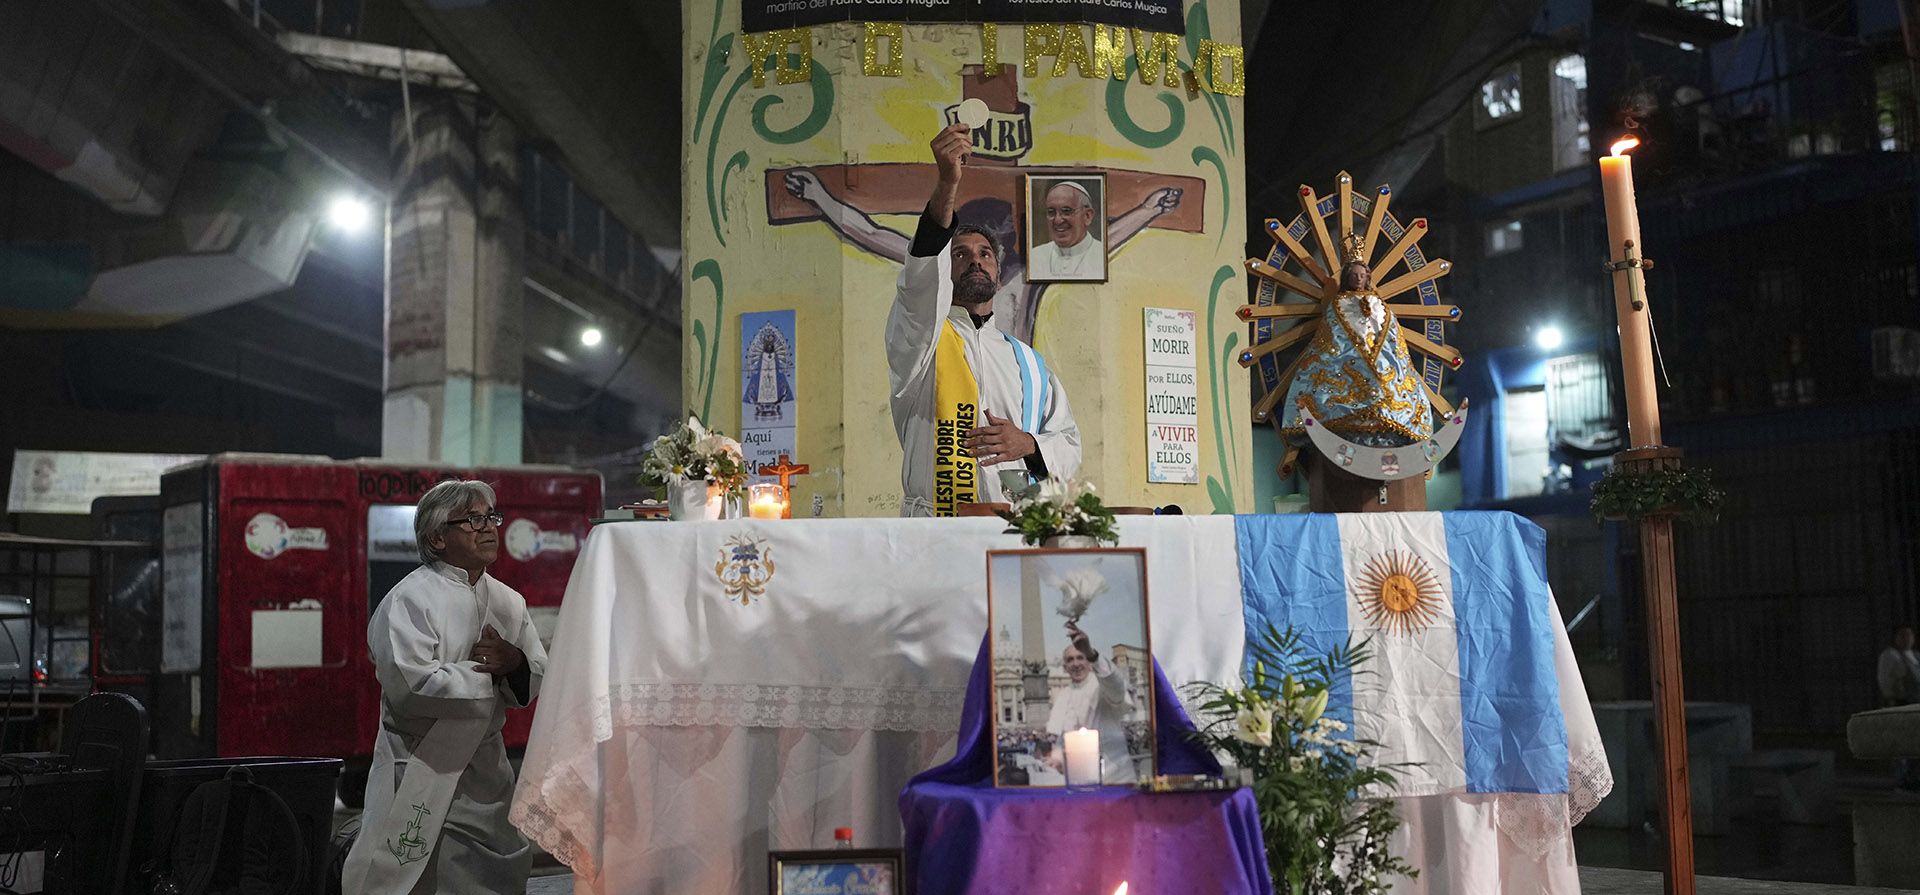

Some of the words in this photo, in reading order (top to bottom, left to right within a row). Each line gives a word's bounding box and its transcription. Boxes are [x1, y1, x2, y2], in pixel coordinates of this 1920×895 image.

[1134, 1, 1168, 15] Mugica
[1271, 249, 1286, 267] DE
[1420, 285, 1436, 299] DE
[1156, 325, 1185, 334] SUEÑO
[1152, 338, 1190, 355] MORIR
[1149, 375, 1164, 383] POR
[1166, 373, 1195, 386] ELLOS,
[1425, 359, 1441, 388] VILLA
[1148, 390, 1197, 416] AYÚDAME
[744, 430, 772, 446] Aquí
[1158, 426, 1196, 442] VIVIR
[936, 419, 954, 466] POBRE
[1163, 443, 1183, 451] PARA
[1156, 451, 1192, 464] ELLOS
[956, 460, 974, 489] LOS
